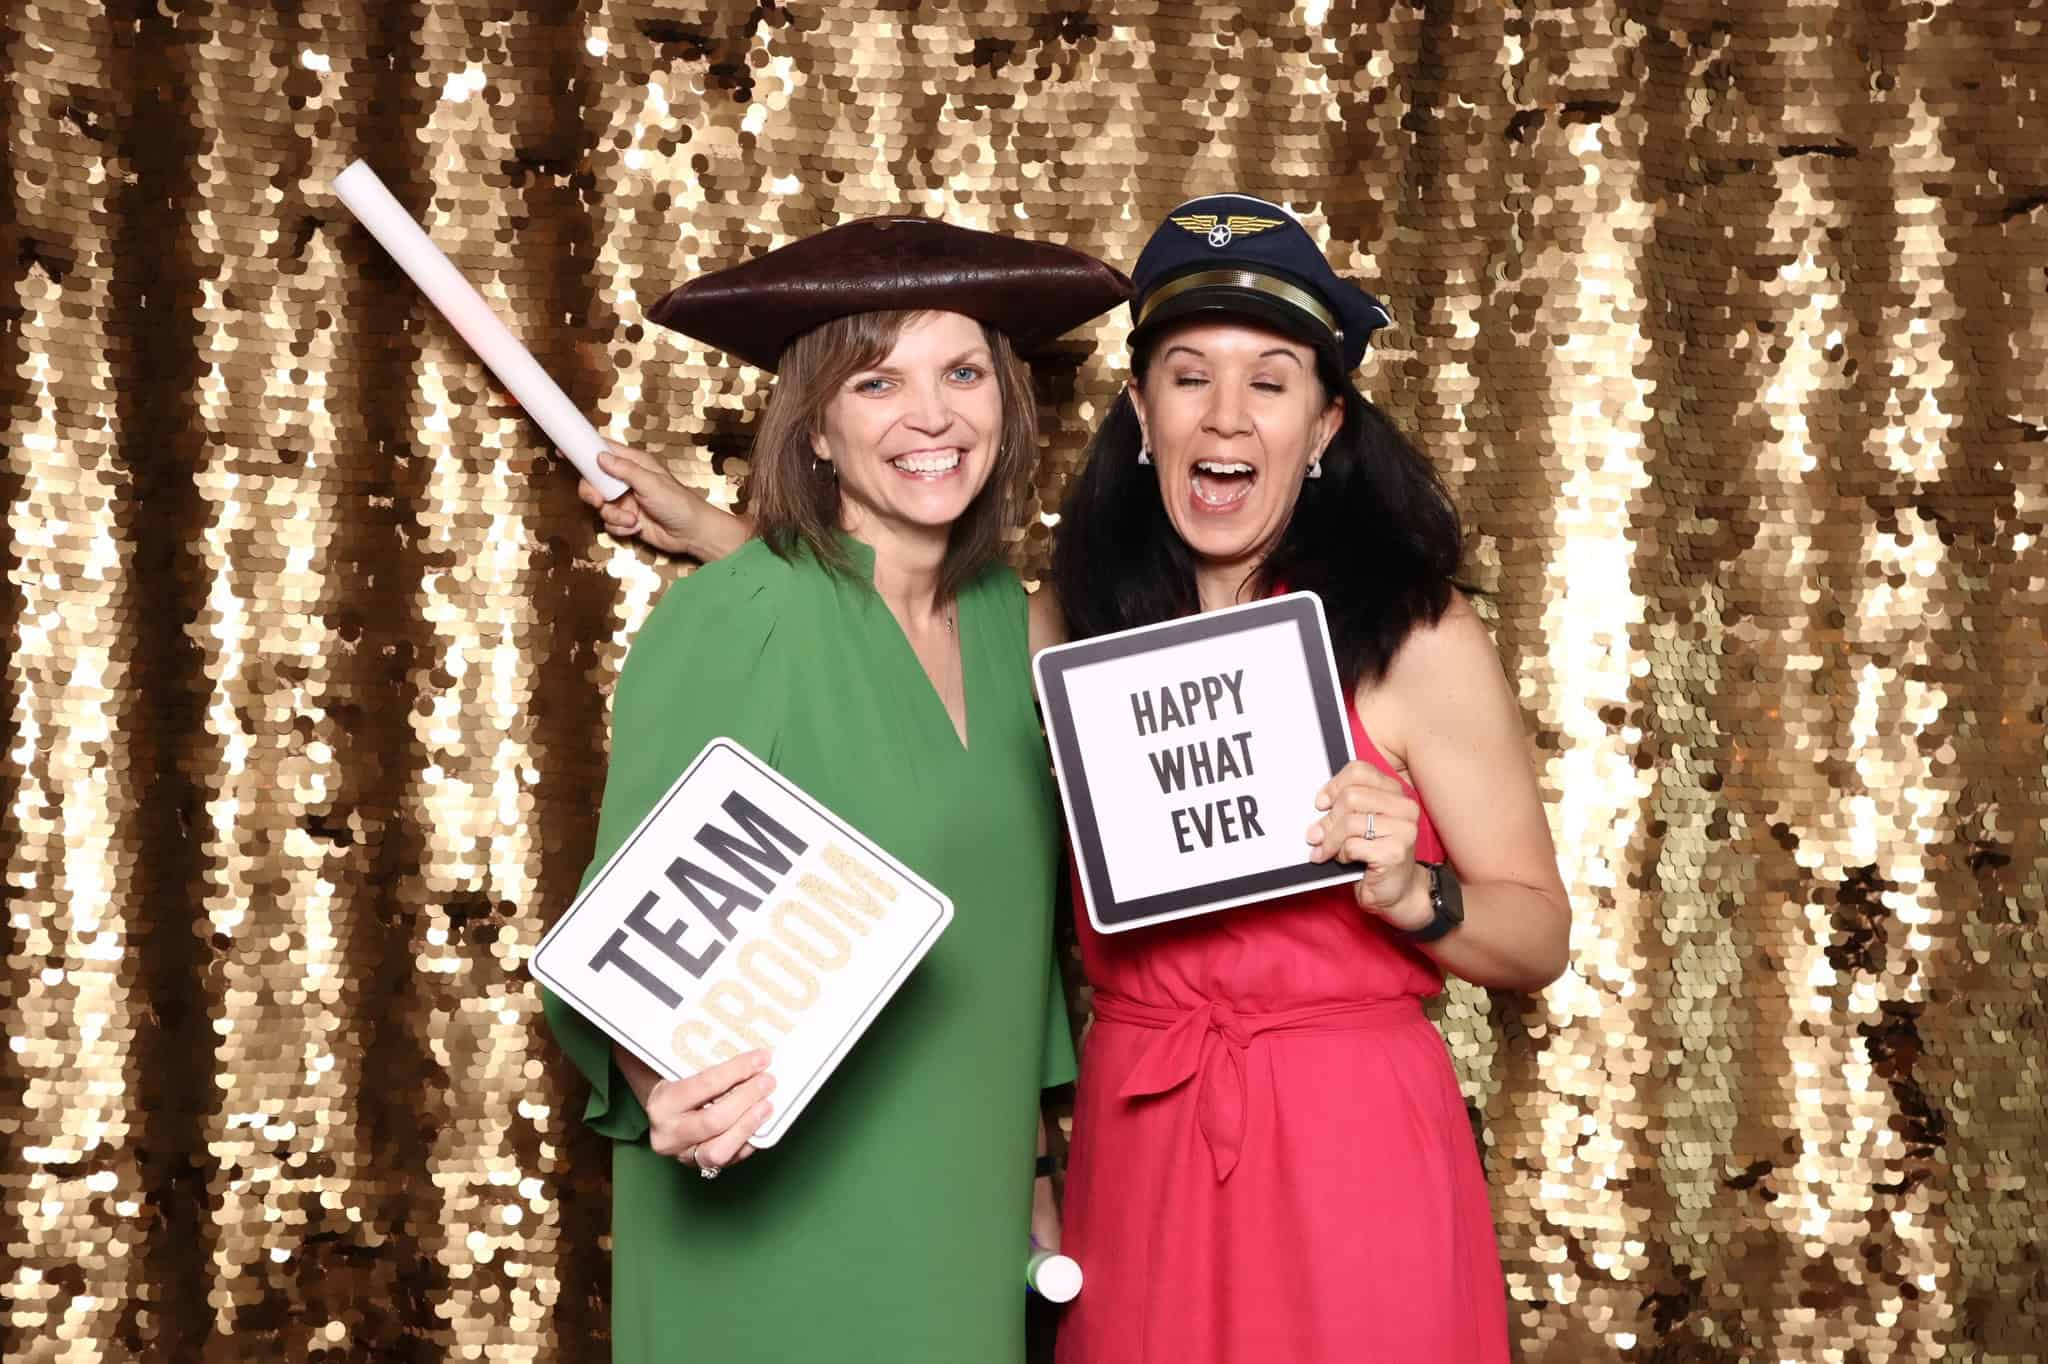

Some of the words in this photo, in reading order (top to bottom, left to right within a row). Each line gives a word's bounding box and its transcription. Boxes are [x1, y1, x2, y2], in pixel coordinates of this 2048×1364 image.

[1130, 670, 1245, 736] HAPPY
[1148, 732, 1255, 794] WHAT
[1171, 795, 1266, 854] EVER
[588, 790, 809, 1010] TEAM
